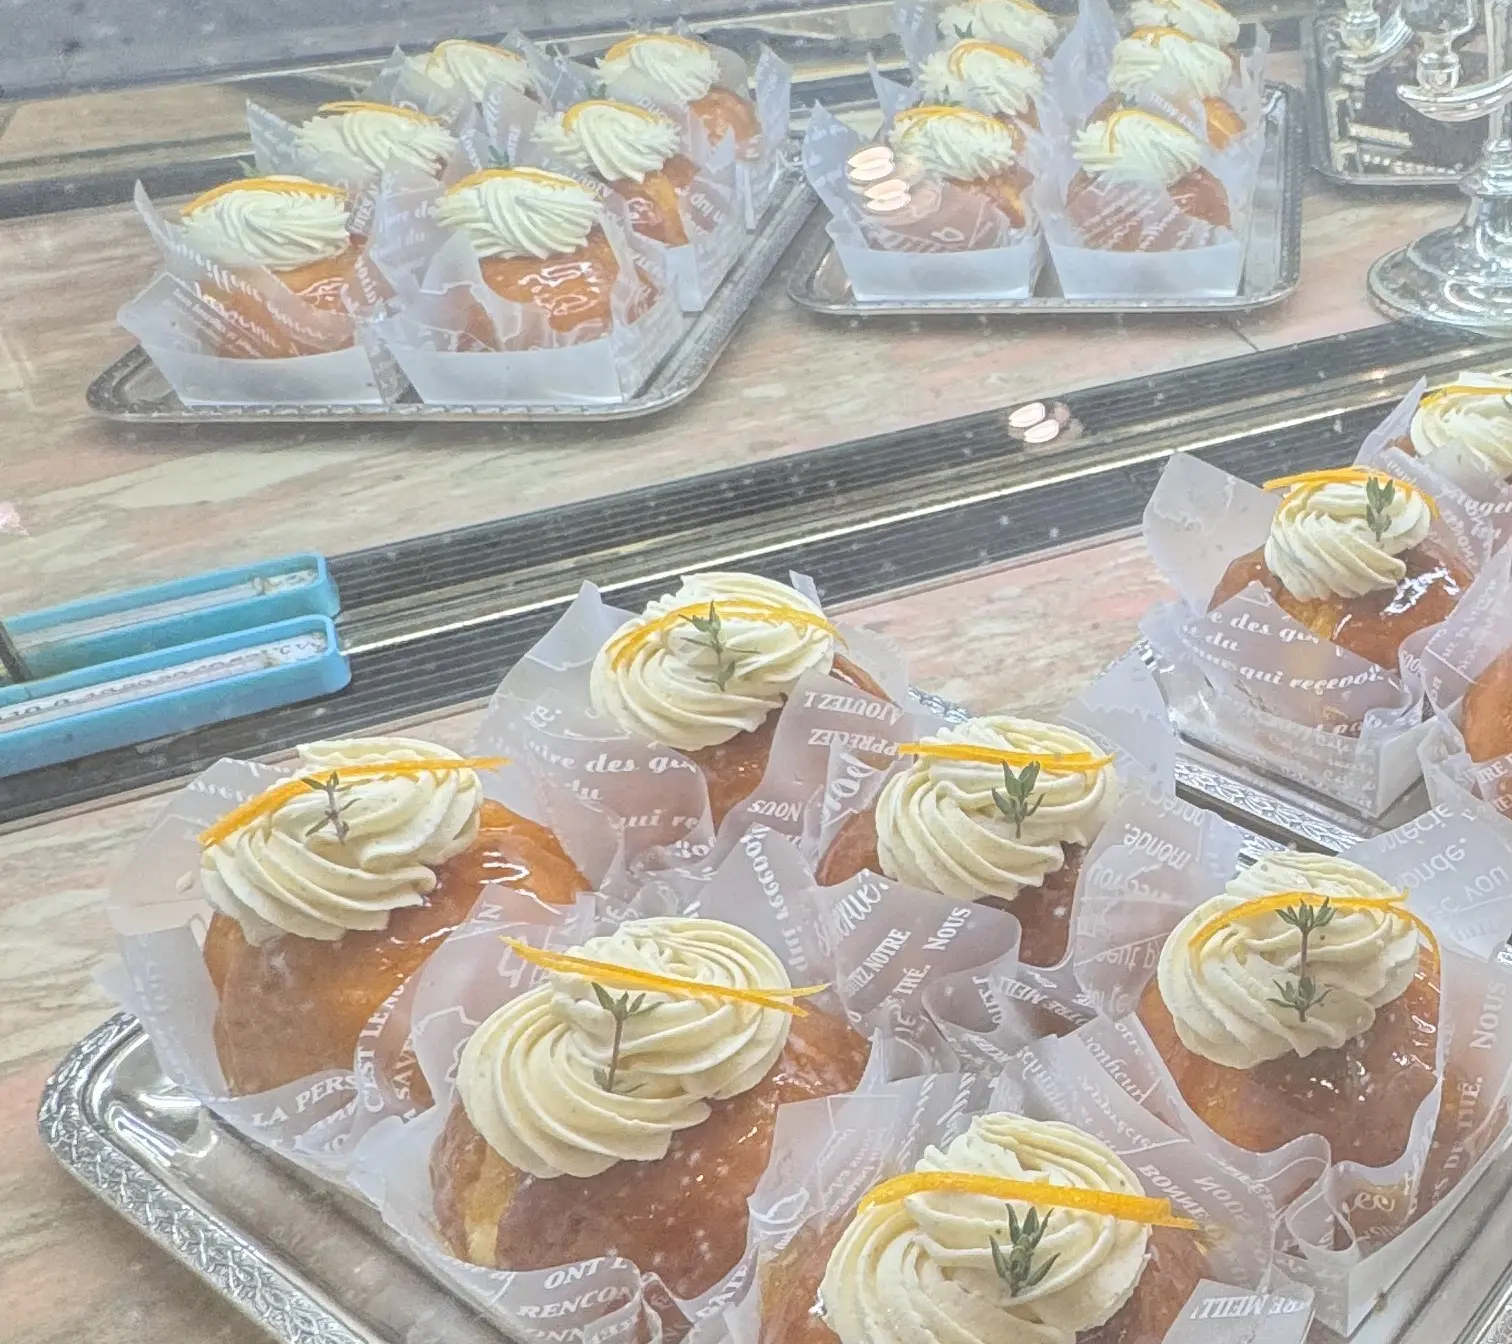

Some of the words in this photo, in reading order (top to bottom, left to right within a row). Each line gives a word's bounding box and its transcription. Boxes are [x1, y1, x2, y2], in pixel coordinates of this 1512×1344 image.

[1229, 612, 1273, 636] des
[1204, 631, 1241, 653] du
[1239, 665, 1285, 686] qui
[817, 692, 905, 727] AJOUTEZ
[585, 752, 639, 774] des
[747, 798, 803, 823] NOUS
[1123, 823, 1193, 872] monde.
[922, 906, 973, 952] NOUS
[868, 927, 913, 974] NOTRE
[1468, 980, 1507, 1051] NOUS
[251, 1105, 290, 1128] LA
[543, 1258, 605, 1290] ONT
